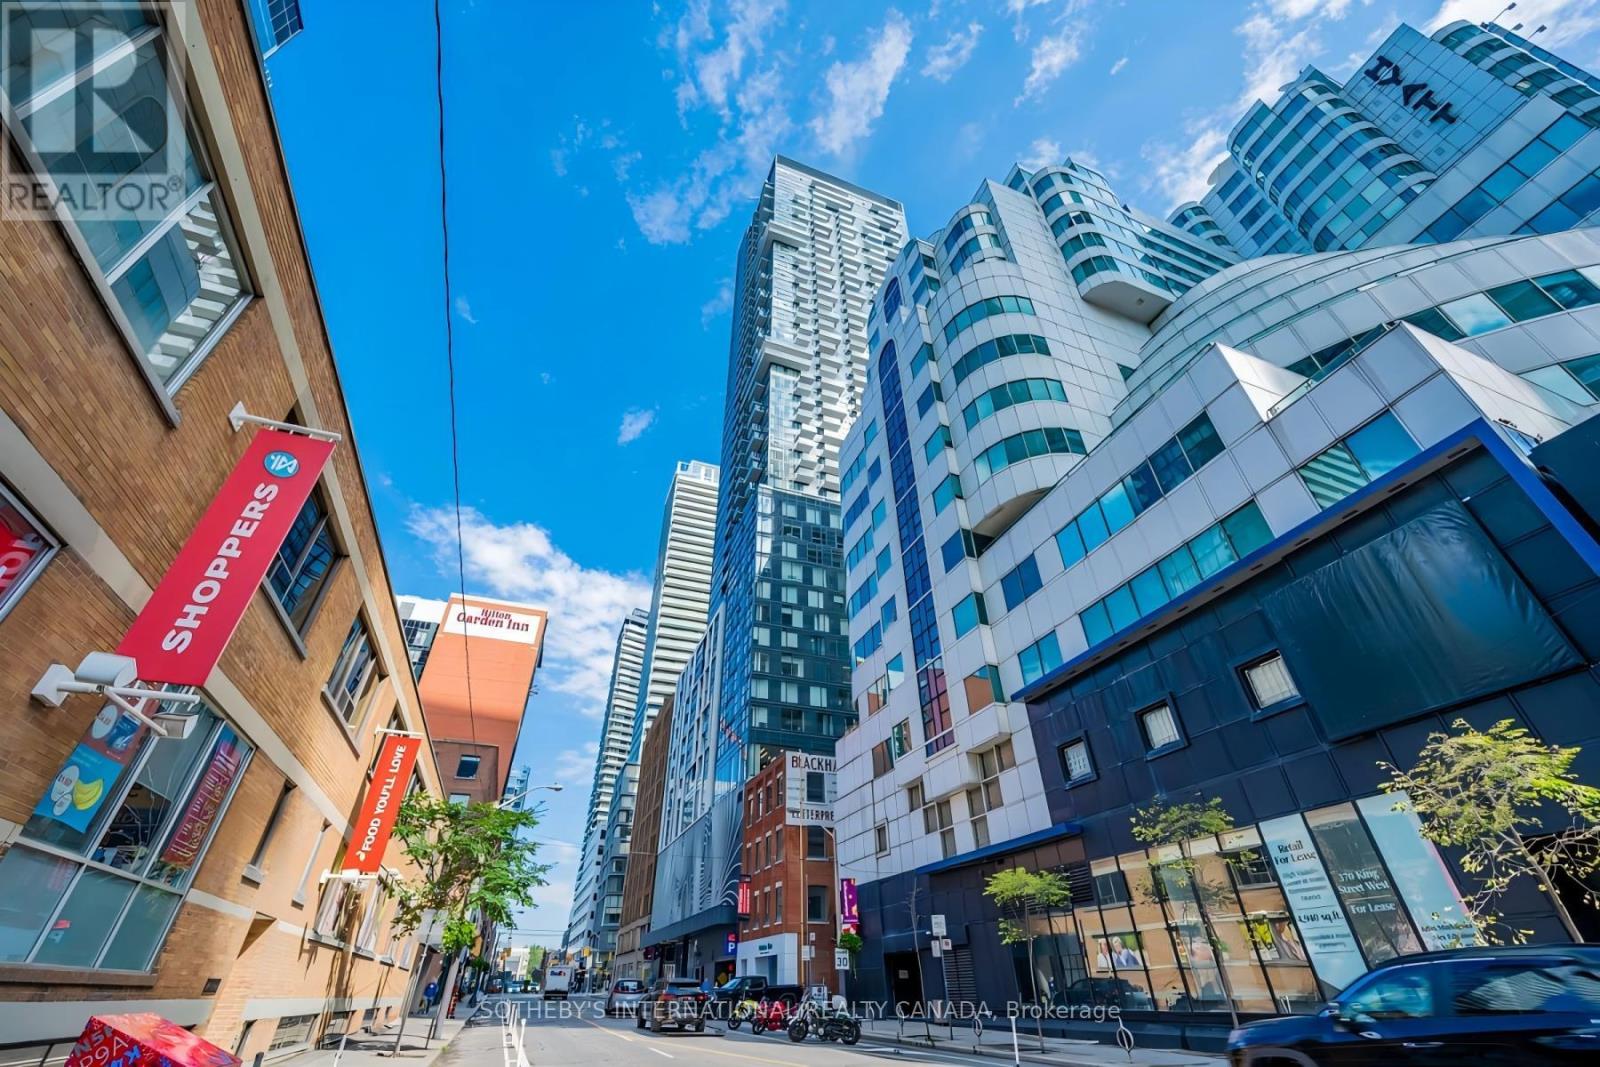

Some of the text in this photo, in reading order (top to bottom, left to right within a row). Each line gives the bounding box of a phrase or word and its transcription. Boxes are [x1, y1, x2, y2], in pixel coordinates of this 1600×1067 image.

[1364, 55, 1457, 124] HYATT
[161, 482, 279, 655] SHOPPERS
[480, 608, 512, 620] Hilton
[456, 612, 530, 632] Garden Inn
[361, 743, 407, 852] FOOD YOU'LL LOVE
[1277, 840, 1304, 854] Retail
[1274, 851, 1317, 866] For Lease
[1355, 868, 1380, 881] King
[1337, 883, 1365, 895] Street
[1366, 880, 1390, 893] West
[1350, 902, 1396, 915] For Lease
[836, 957, 848, 967] 30
